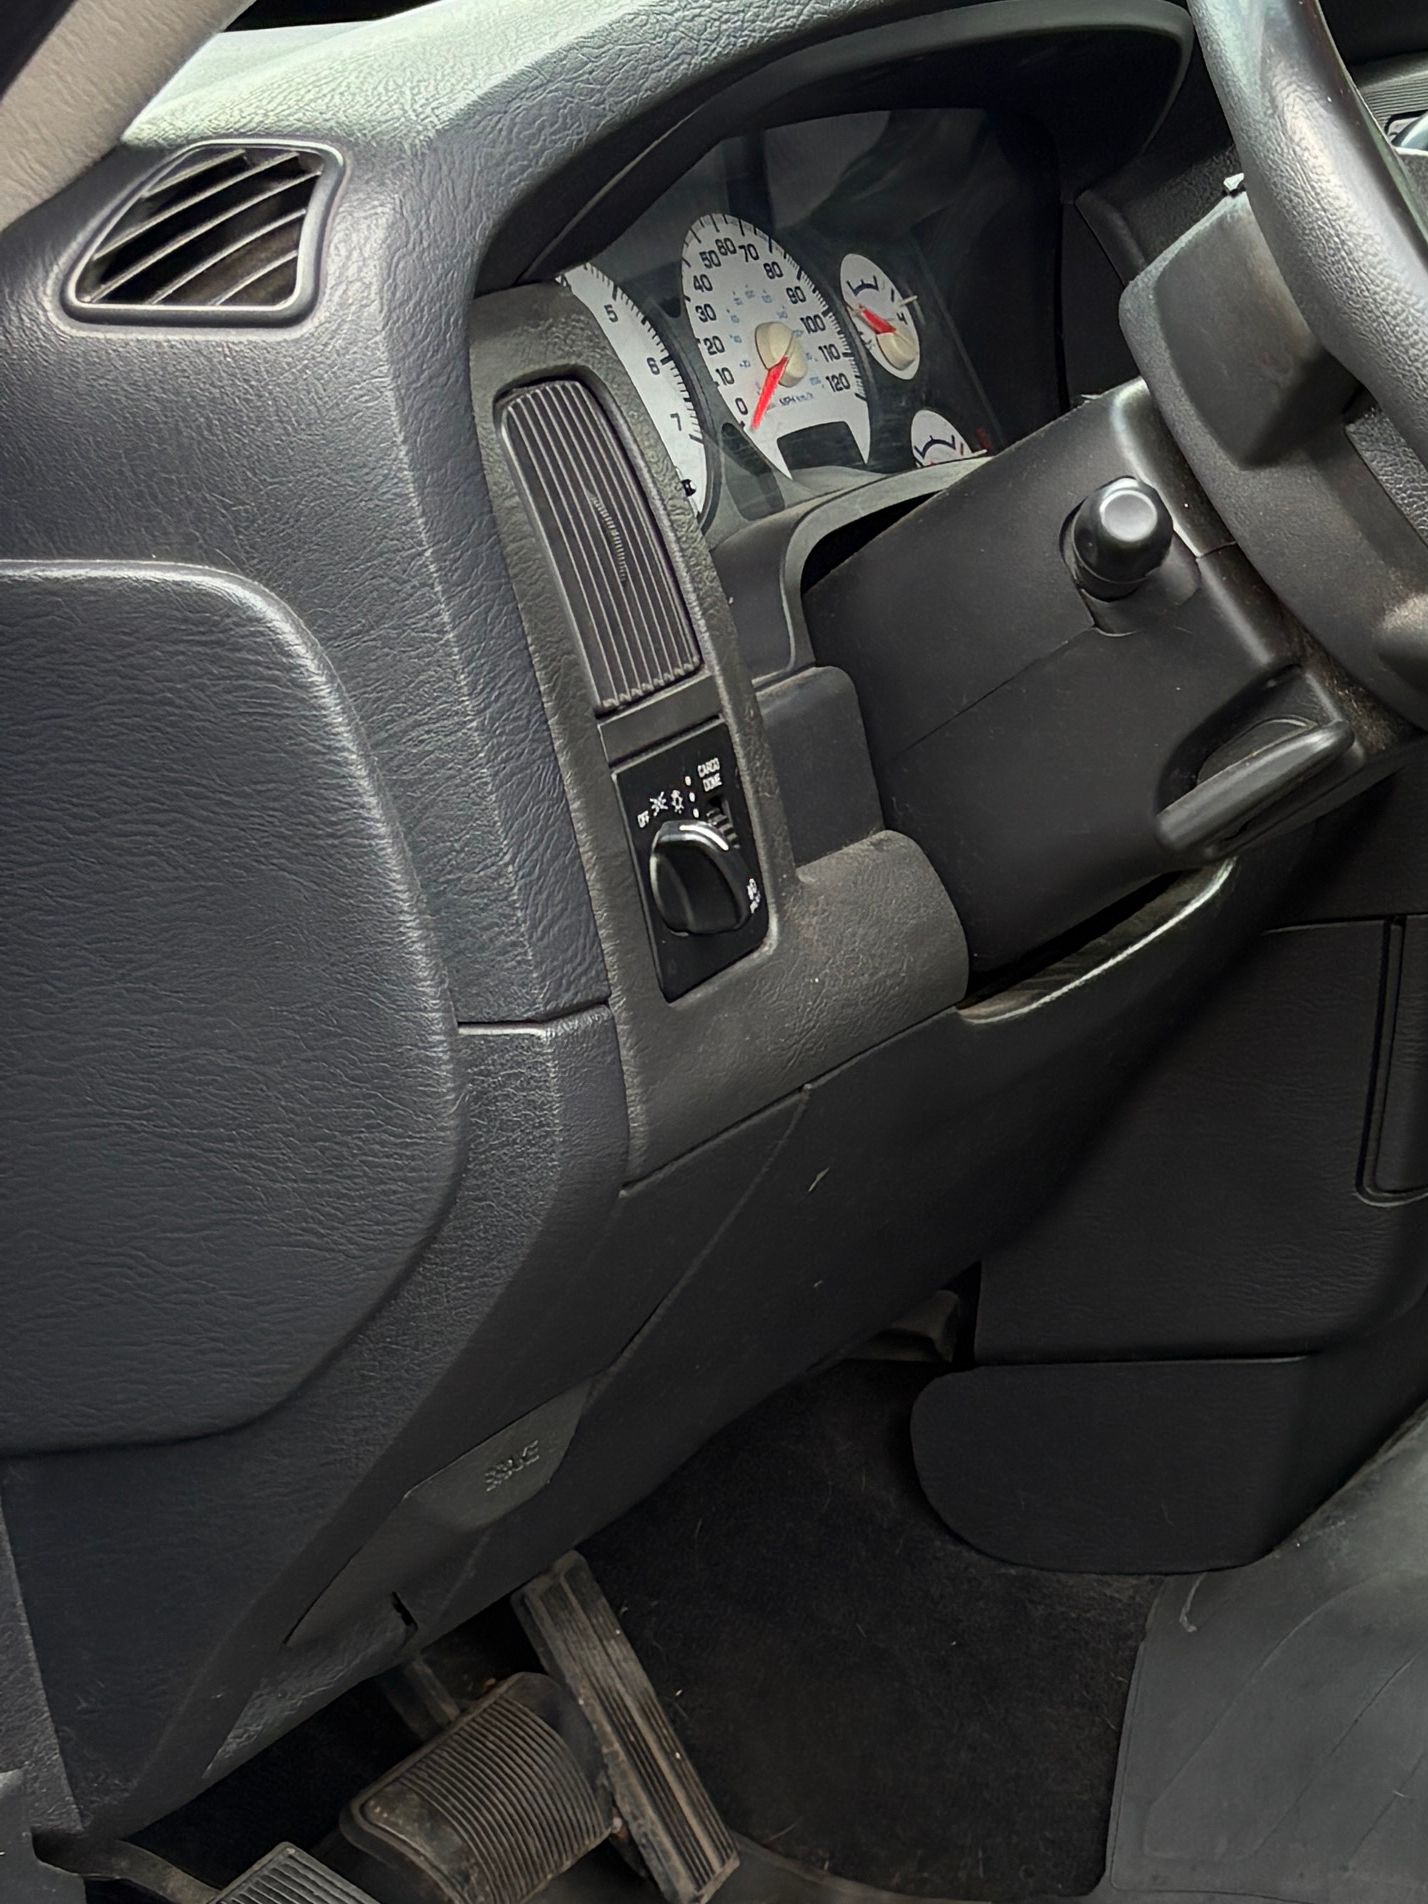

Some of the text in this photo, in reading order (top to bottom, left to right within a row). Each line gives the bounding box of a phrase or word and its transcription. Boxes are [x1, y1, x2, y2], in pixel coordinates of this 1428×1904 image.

[699, 250, 722, 269] 50
[738, 243, 760, 263] 70
[763, 261, 784, 280] 80
[693, 274, 713, 293] 40
[603, 303, 619, 324] 5
[695, 303, 717, 323] 30
[800, 314, 827, 335] 100
[703, 335, 726, 356] 20
[818, 343, 841, 363] 110
[646, 356, 661, 376] 6
[715, 366, 735, 386] 10
[825, 372, 851, 393] 120
[735, 397, 749, 416] 0
[670, 412, 683, 432] 7
